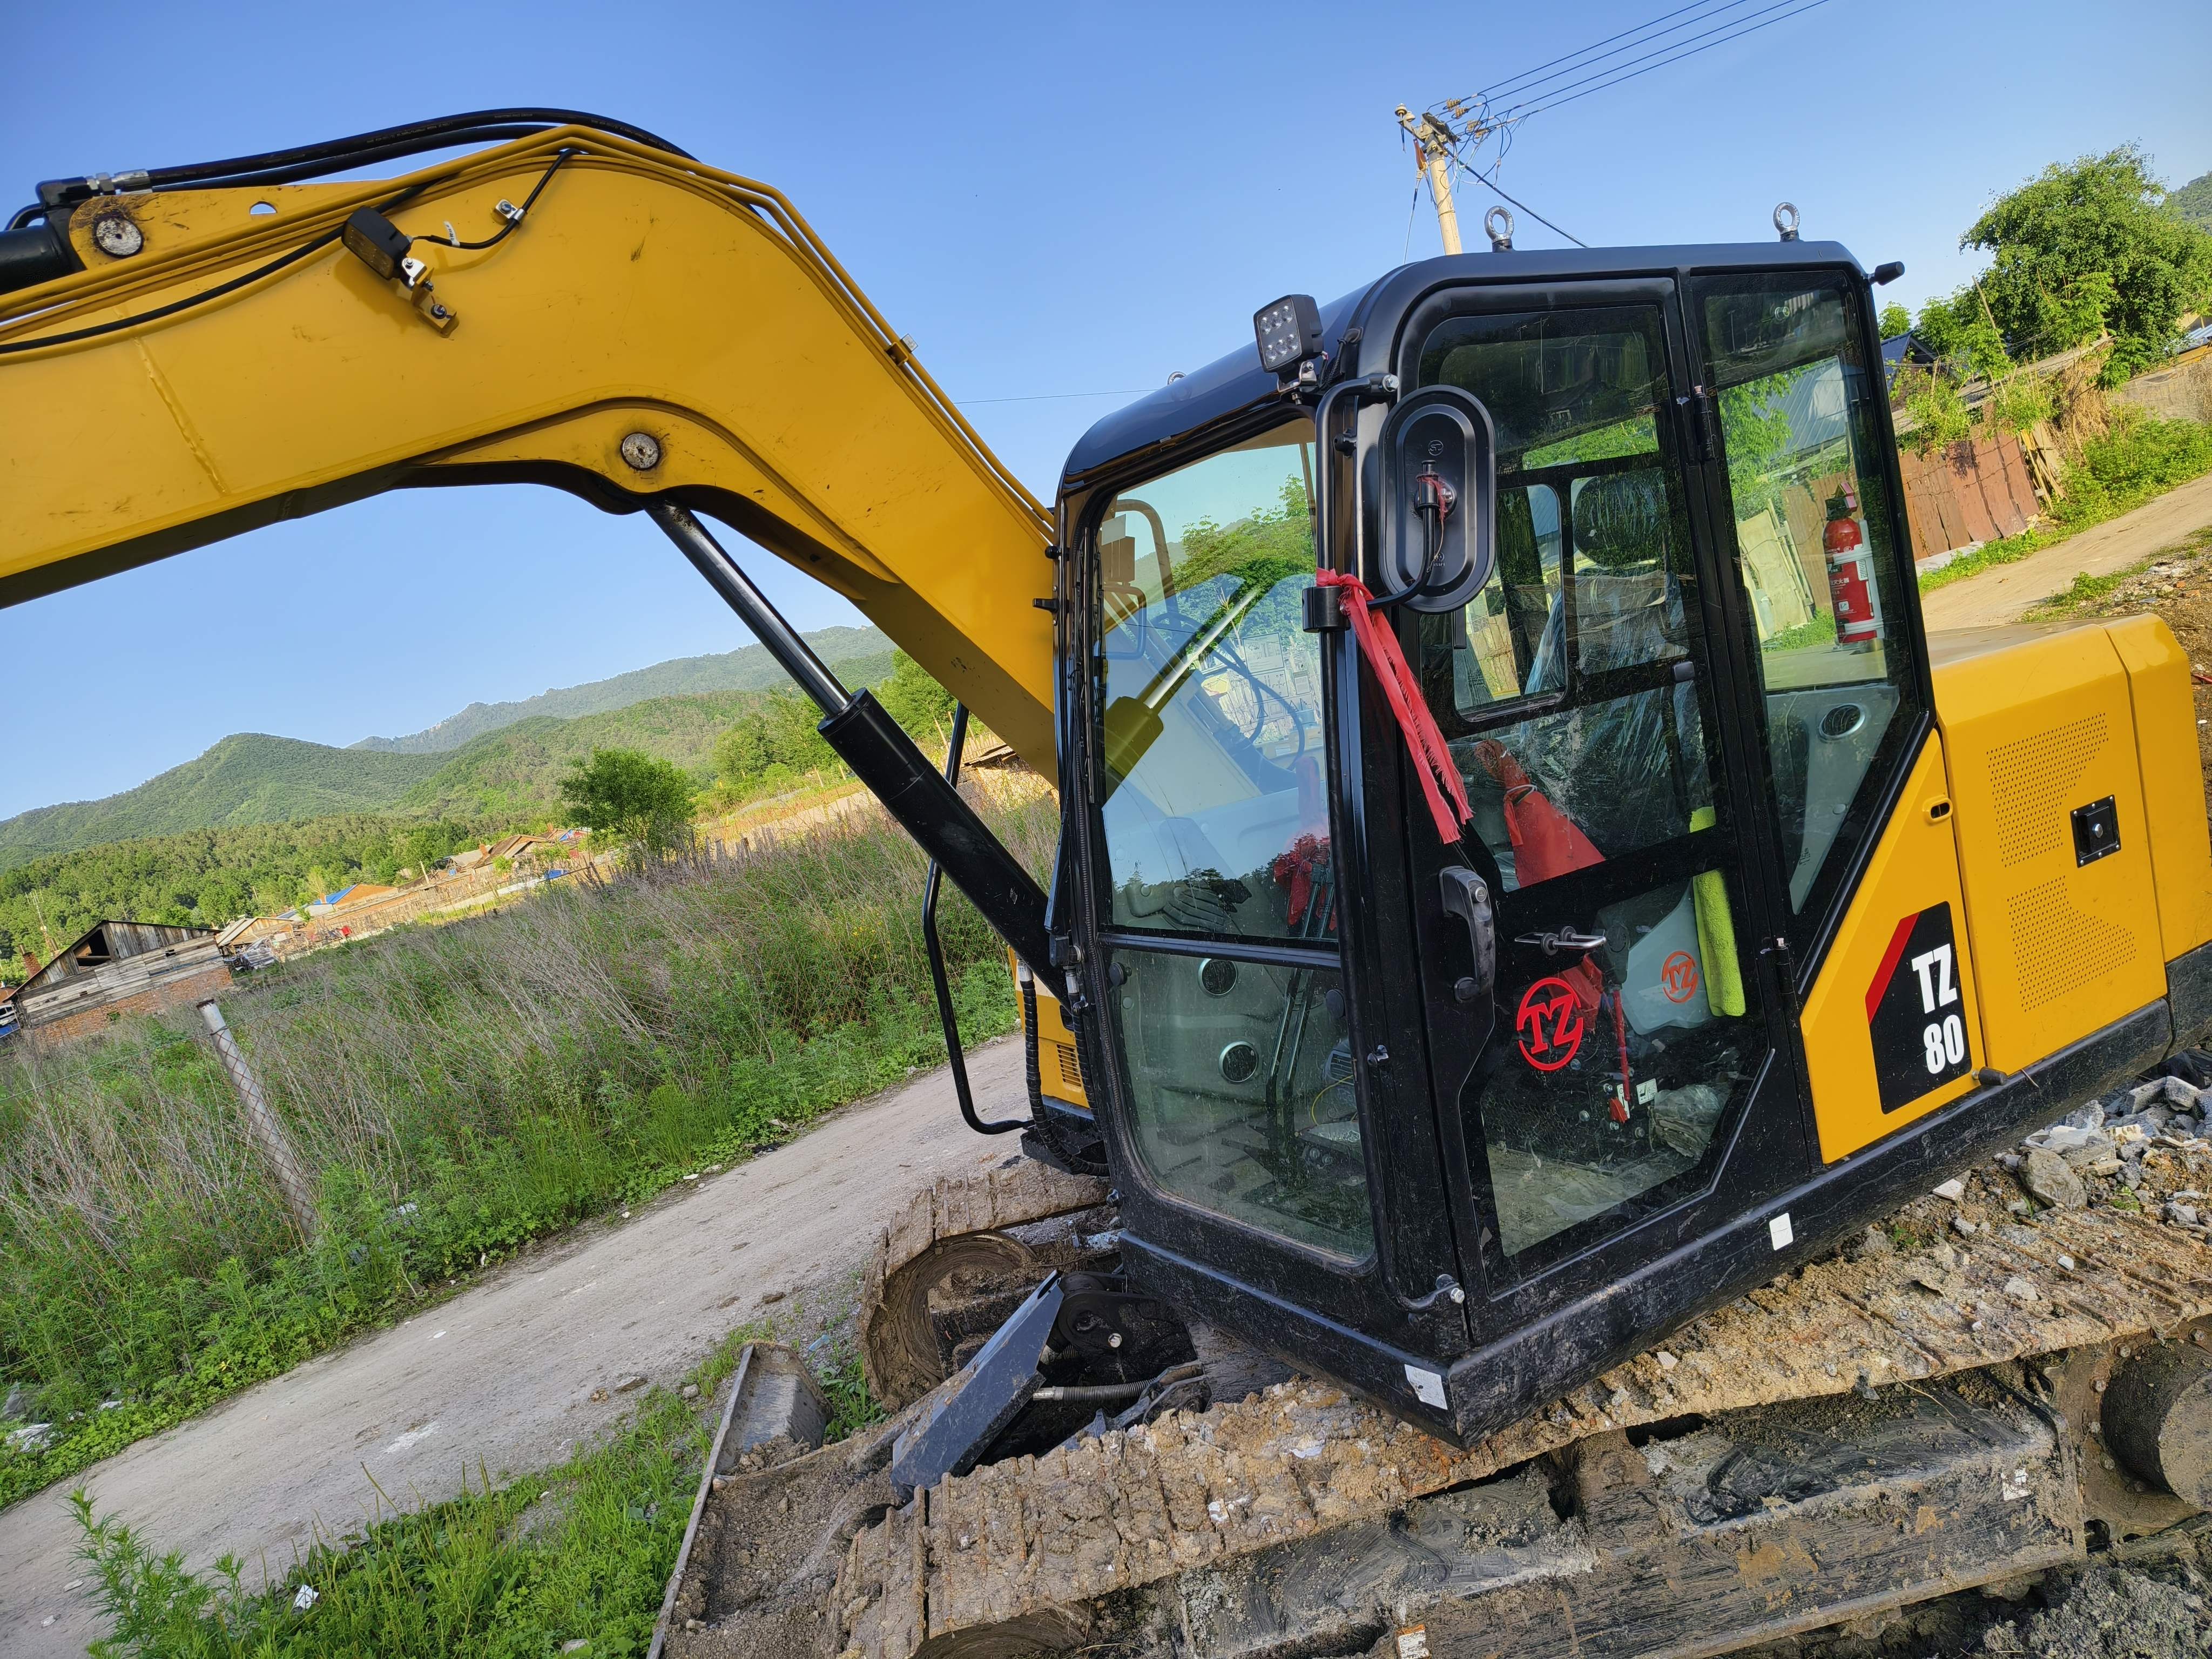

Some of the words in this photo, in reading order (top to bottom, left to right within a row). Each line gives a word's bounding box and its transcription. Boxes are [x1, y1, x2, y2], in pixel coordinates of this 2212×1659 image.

[1911, 943, 1958, 1014] TZ
[1517, 993, 1583, 1055] TZ
[1923, 1014, 1965, 1075] 80
